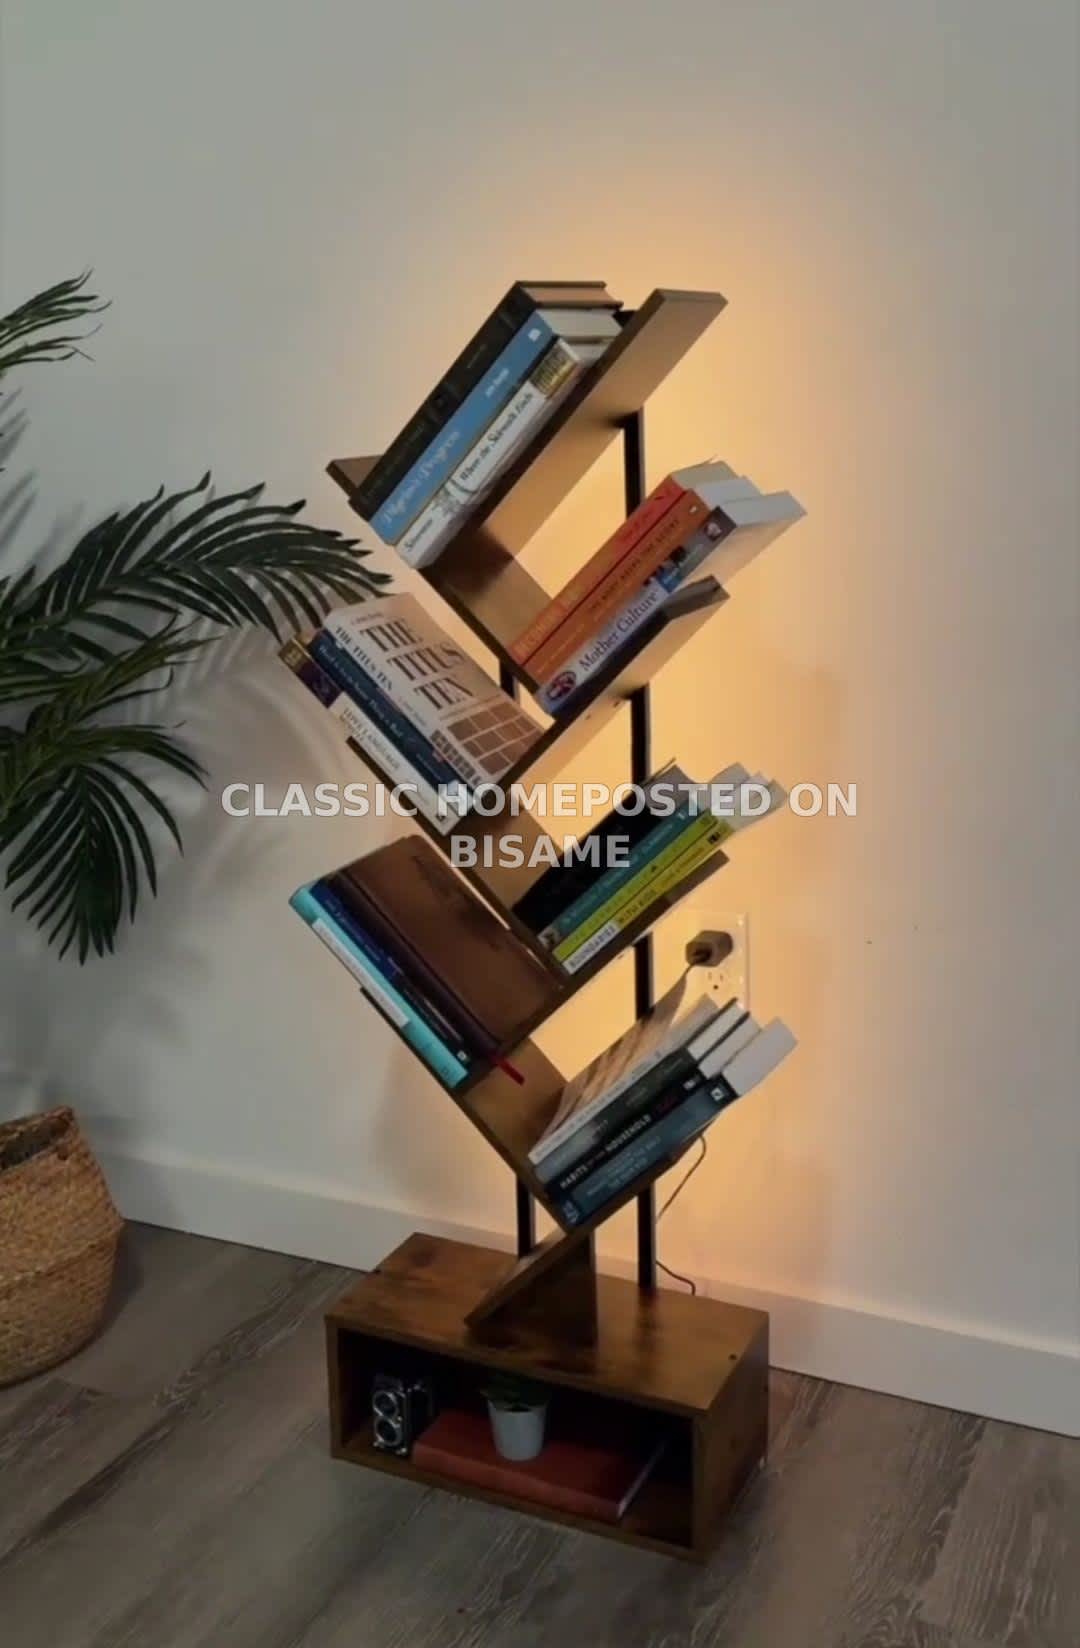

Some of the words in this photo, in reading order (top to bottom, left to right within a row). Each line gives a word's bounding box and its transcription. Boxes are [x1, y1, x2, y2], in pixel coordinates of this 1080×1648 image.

[359, 617, 423, 653] THE
[578, 632, 620, 672] Mother
[616, 590, 659, 635] Culture
[334, 626, 353, 646] THE
[351, 645, 378, 673] TITUS
[375, 671, 394, 691] TEN
[386, 647, 465, 682] TITUS
[560, 1164, 588, 1189] HABITS
